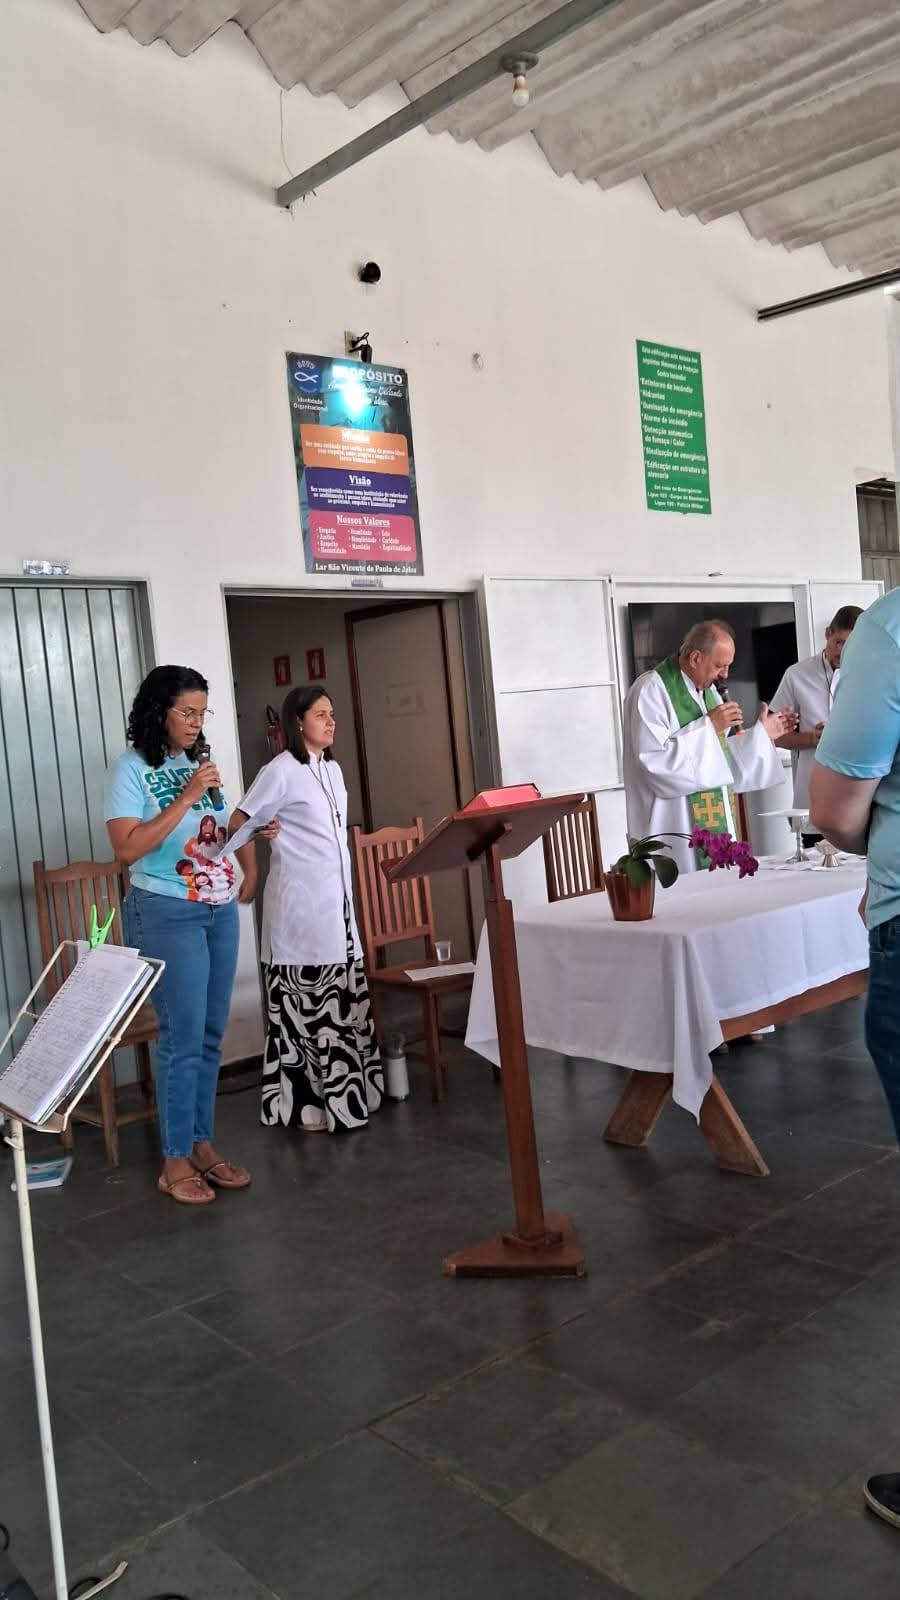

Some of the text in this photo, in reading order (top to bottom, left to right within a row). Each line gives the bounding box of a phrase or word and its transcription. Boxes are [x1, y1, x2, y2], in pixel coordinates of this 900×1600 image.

[349, 474, 372, 485] Visão
[336, 514, 390, 526] Nossos Valores
[315, 563, 327, 571] Lar
[328, 563, 341, 571] São
[341, 564, 365, 572] Vicente
[375, 565, 393, 573] Paula
[393, 565, 401, 573] de
